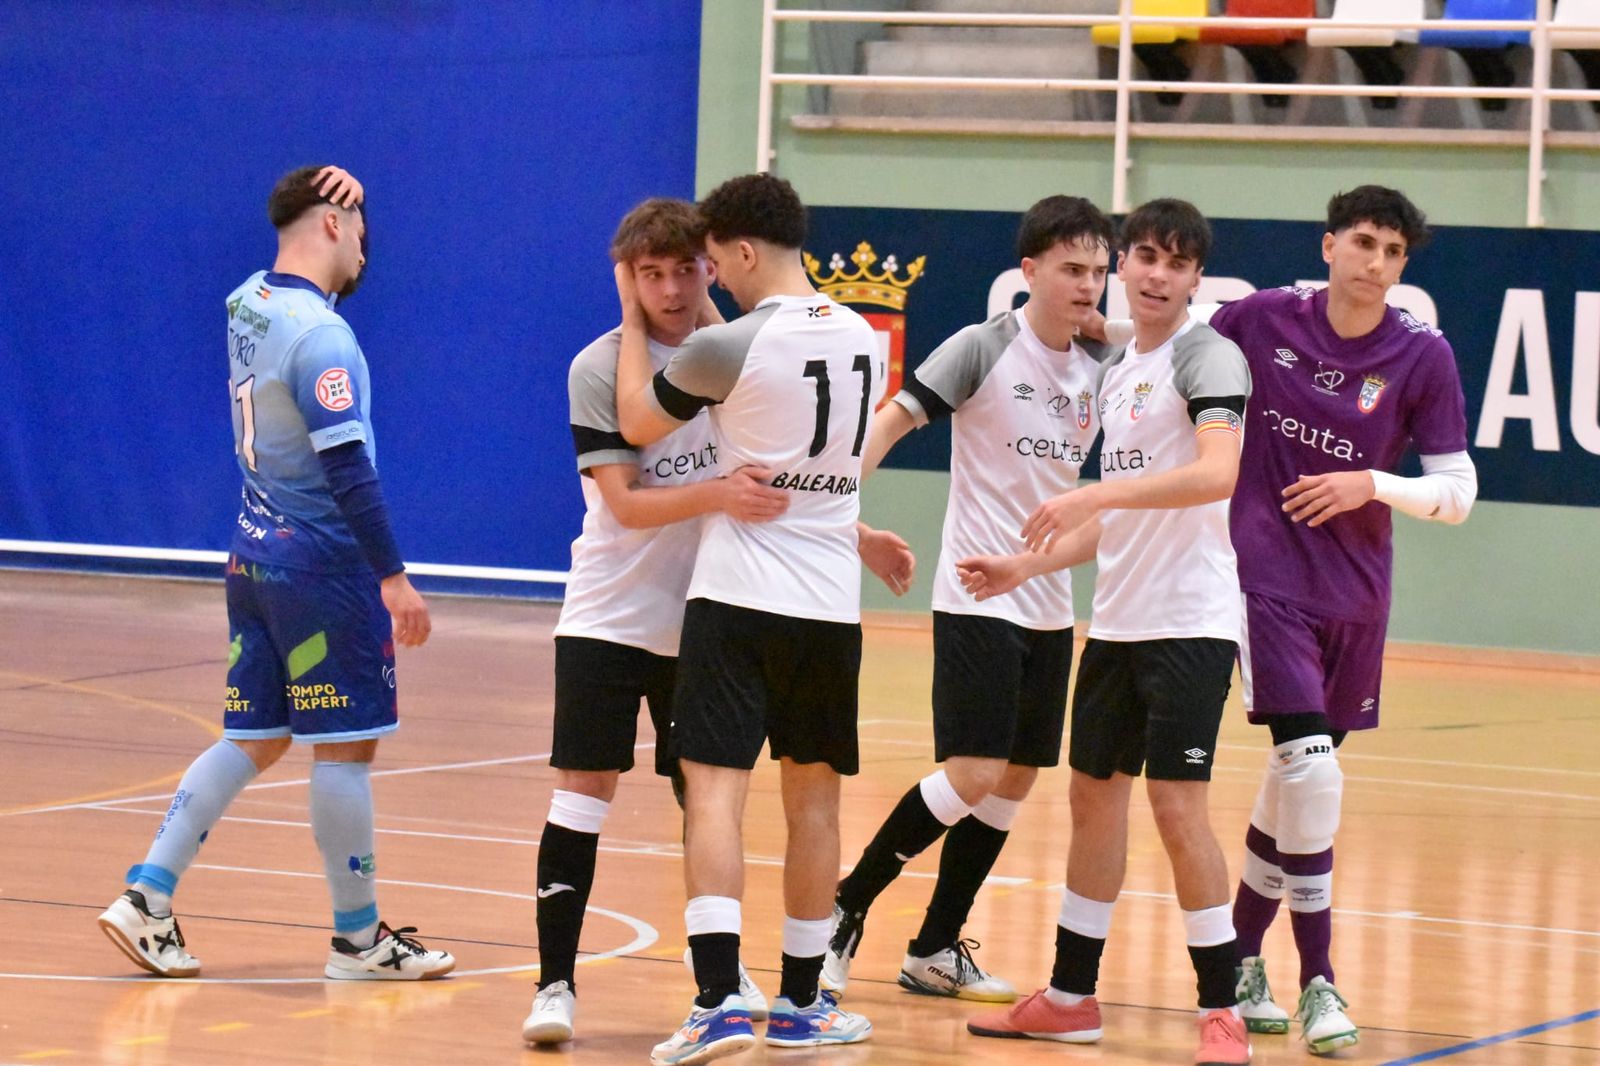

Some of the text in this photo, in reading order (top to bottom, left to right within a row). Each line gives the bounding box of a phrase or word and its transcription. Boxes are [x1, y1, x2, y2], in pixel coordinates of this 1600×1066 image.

[802, 354, 872, 458] 11
[654, 442, 718, 479] ceut
[294, 695, 349, 711] EXPERT
